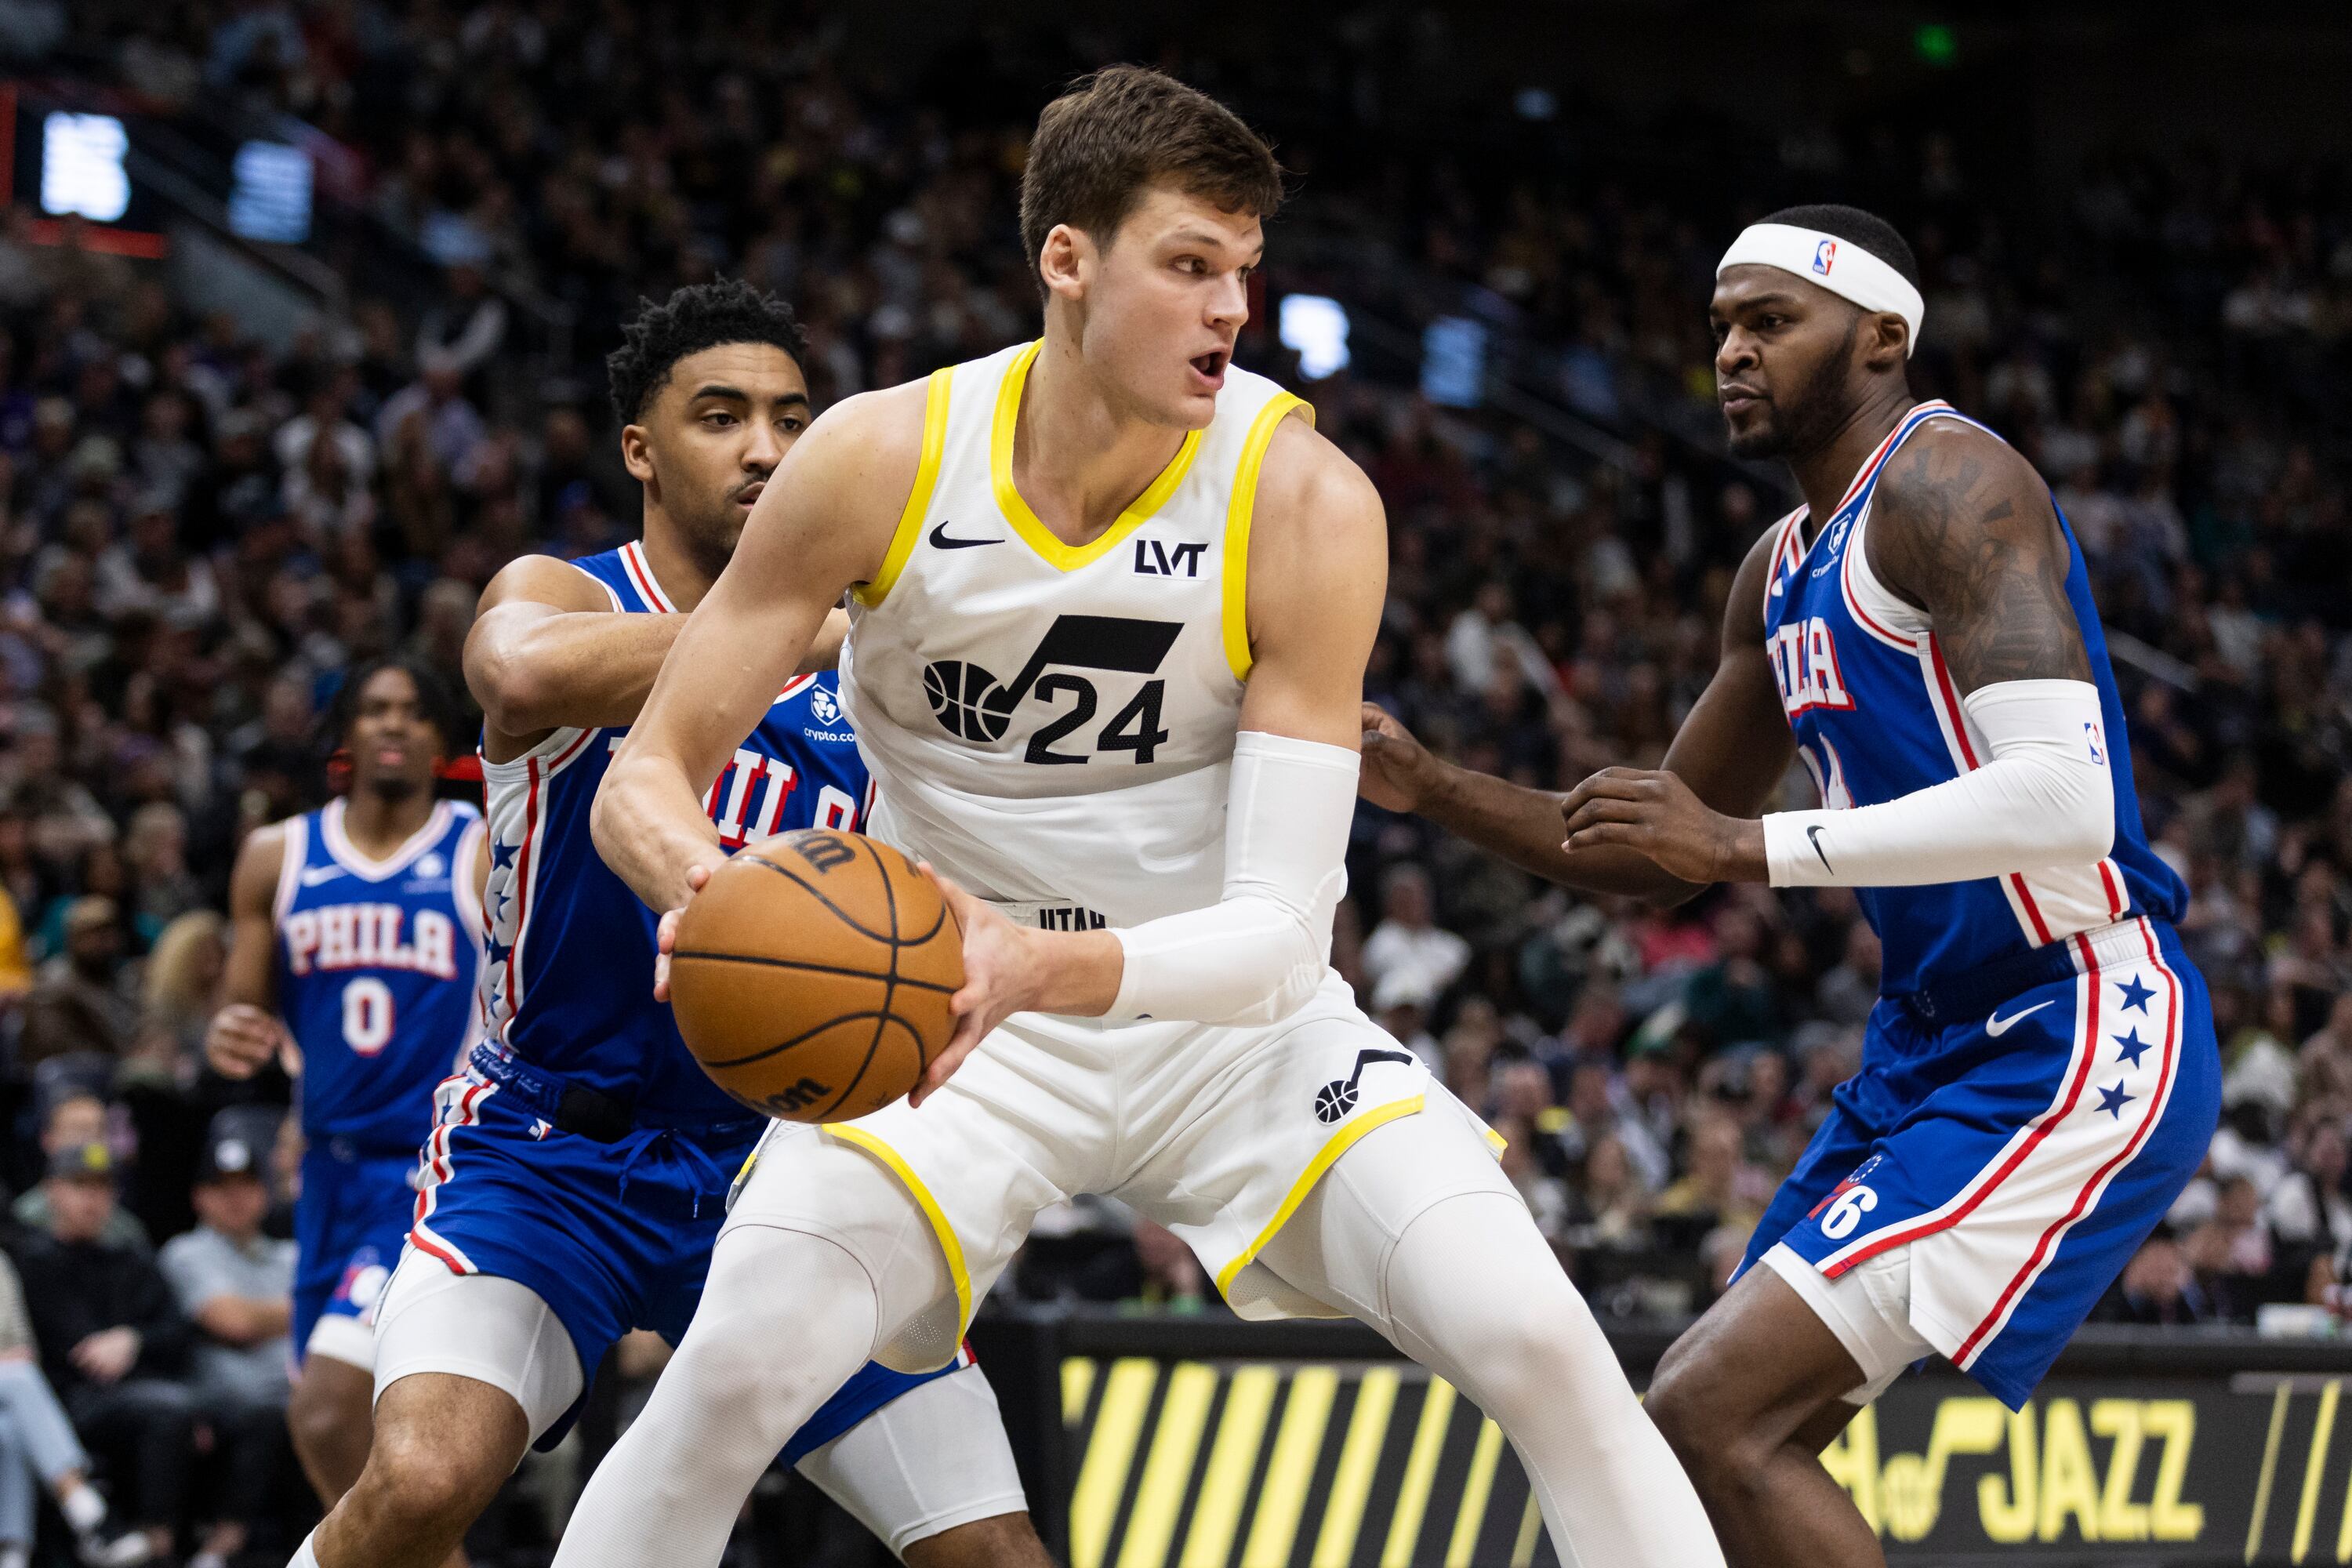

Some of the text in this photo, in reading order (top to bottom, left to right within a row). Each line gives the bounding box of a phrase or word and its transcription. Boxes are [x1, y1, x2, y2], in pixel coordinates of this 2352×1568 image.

[1134, 539, 1208, 576] LVT
[804, 727, 855, 742] crypto.co
[1023, 673, 1169, 764] 24
[284, 902, 459, 980] PHILA
[342, 976, 396, 1057] 0
[1977, 1398, 2205, 1543] JAZZ
